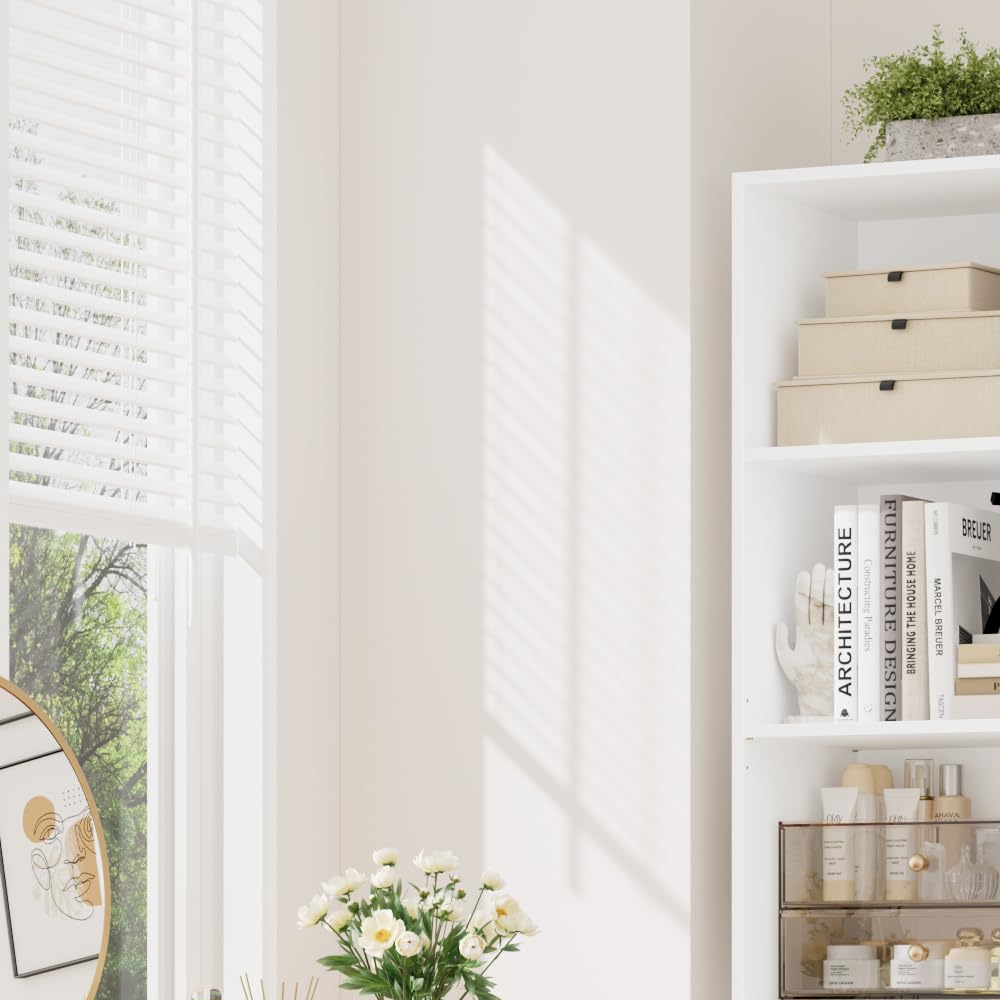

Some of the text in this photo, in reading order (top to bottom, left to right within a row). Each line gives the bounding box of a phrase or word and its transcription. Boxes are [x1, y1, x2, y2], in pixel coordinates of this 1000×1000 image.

[961, 518, 992, 543] BREUER
[838, 527, 852, 697] ARCHITECTURE
[884, 499, 897, 721] FURNITURE DESIGN
[906, 551, 916, 674] BRINGING THE HOUSE HOME
[934, 578, 944, 656] MARCEL BREUER
